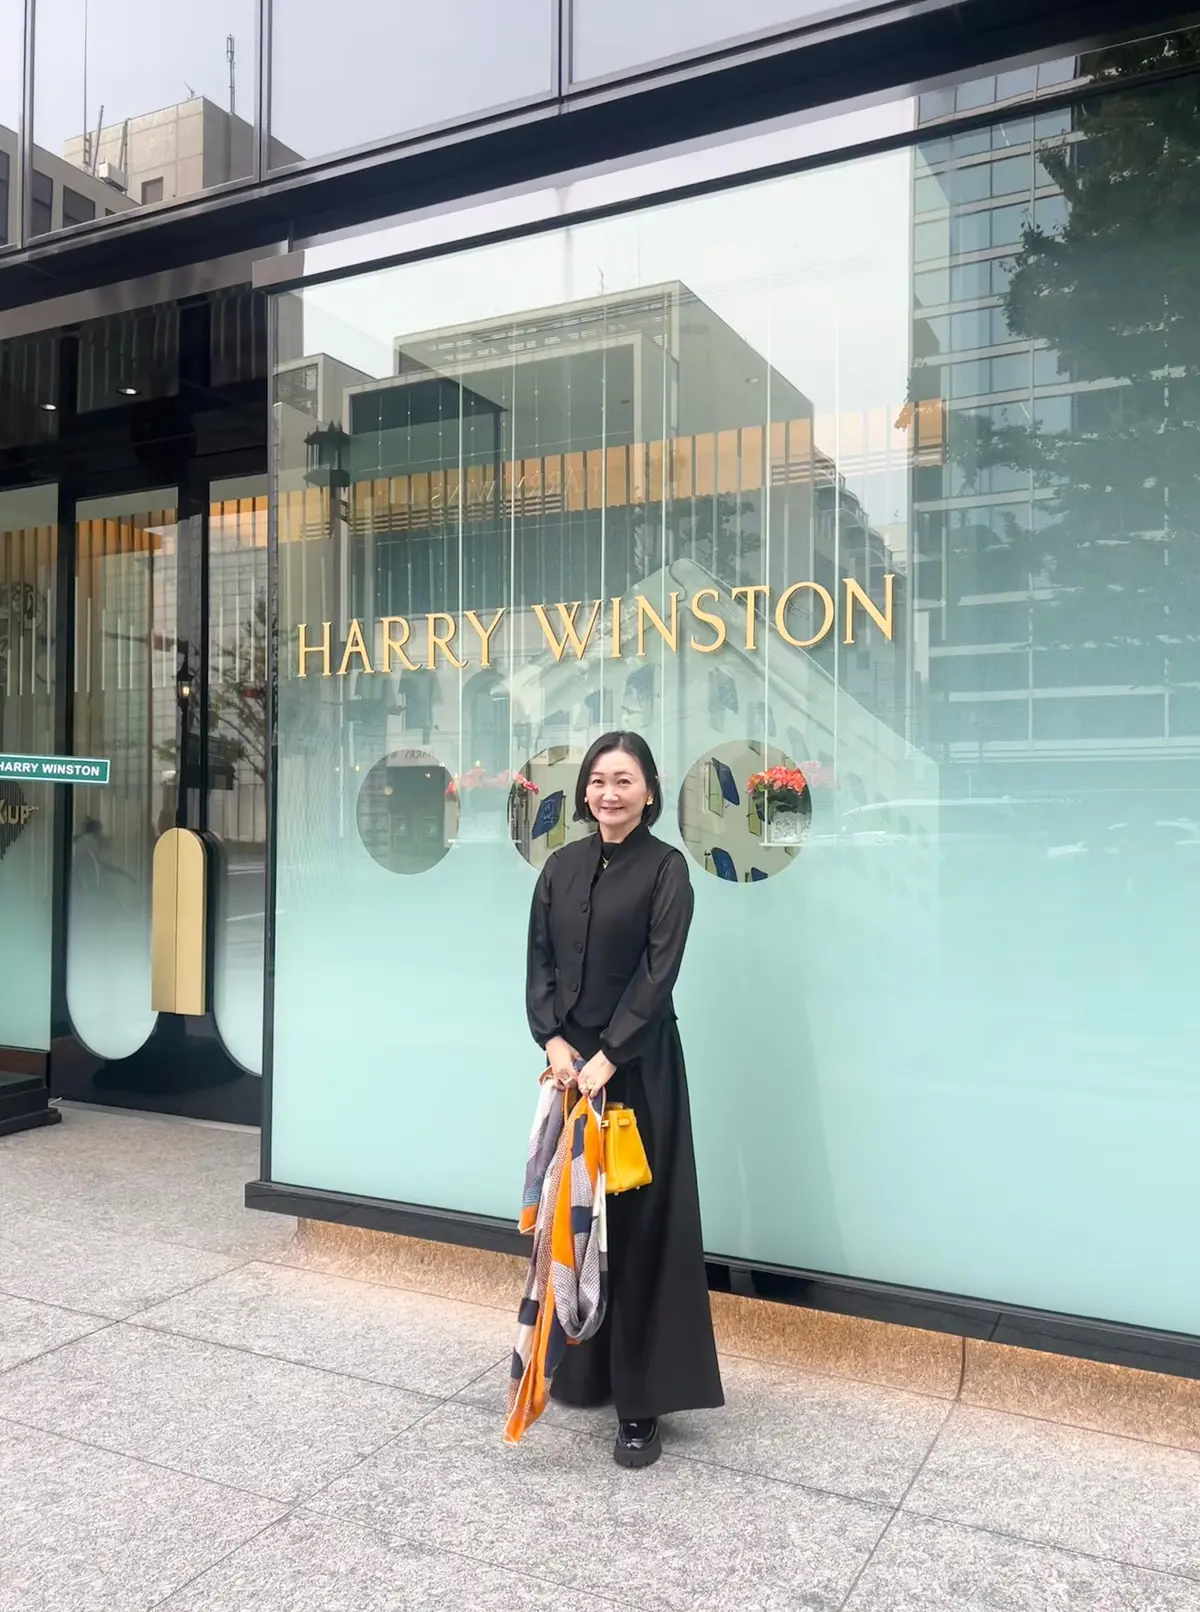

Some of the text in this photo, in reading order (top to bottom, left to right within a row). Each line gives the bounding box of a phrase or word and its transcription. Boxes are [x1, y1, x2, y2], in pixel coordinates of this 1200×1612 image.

[297, 574, 895, 677] HARRY WINSTON
[41, 763, 100, 776] WINSTON
